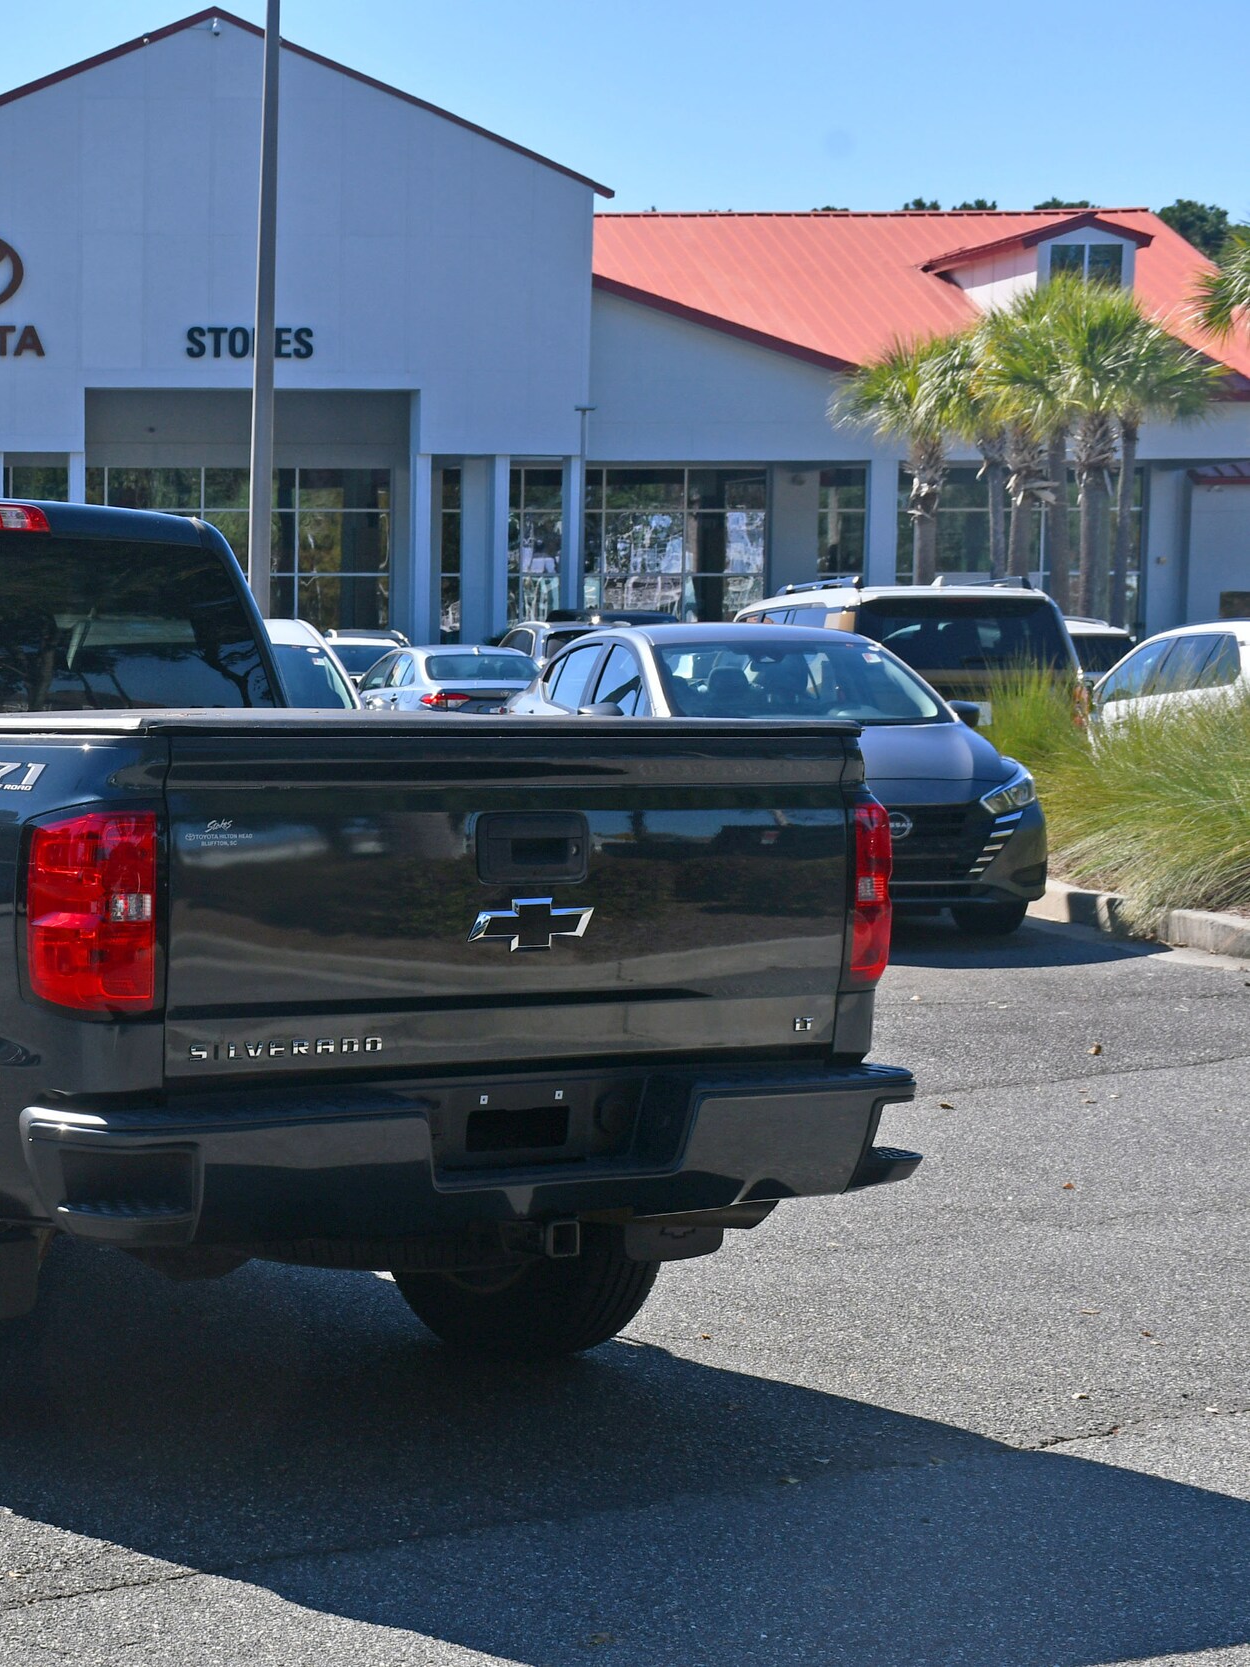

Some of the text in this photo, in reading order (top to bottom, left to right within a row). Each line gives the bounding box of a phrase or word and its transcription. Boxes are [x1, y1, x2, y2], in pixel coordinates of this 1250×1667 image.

[186, 326, 314, 359] STOES
[793, 1016, 814, 1031] LT
[189, 1036, 383, 1061] SILVERADO
